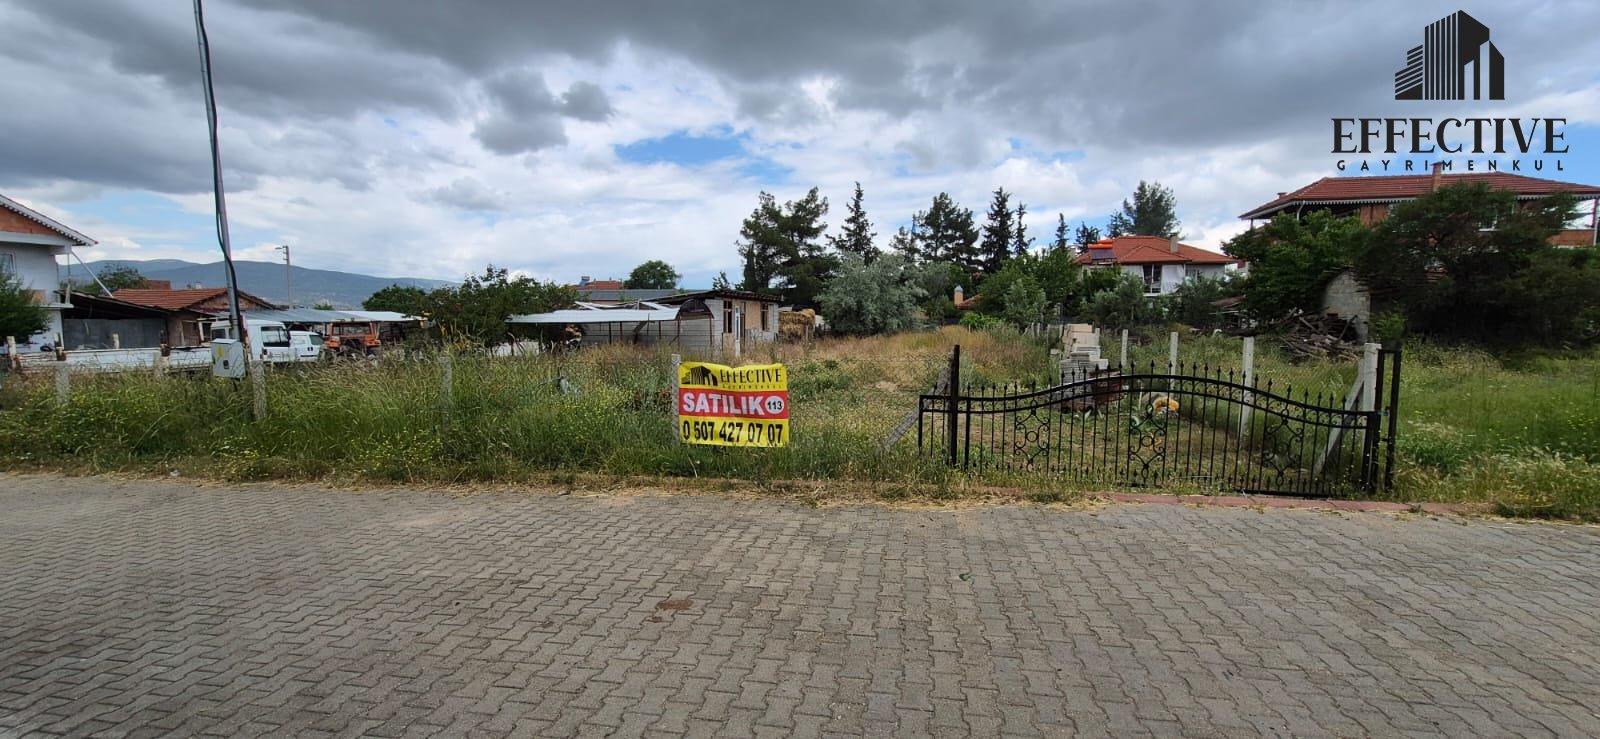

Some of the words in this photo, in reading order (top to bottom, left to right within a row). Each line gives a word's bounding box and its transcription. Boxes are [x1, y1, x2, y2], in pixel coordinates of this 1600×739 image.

[720, 369, 782, 383] EFFECTIVE
[683, 393, 765, 415] SATILIK
[767, 401, 782, 410] 113
[683, 420, 690, 440] 0
[694, 421, 715, 441] 507
[719, 422, 743, 442] 427
[748, 422, 763, 443] 07
[767, 424, 783, 443] 07
